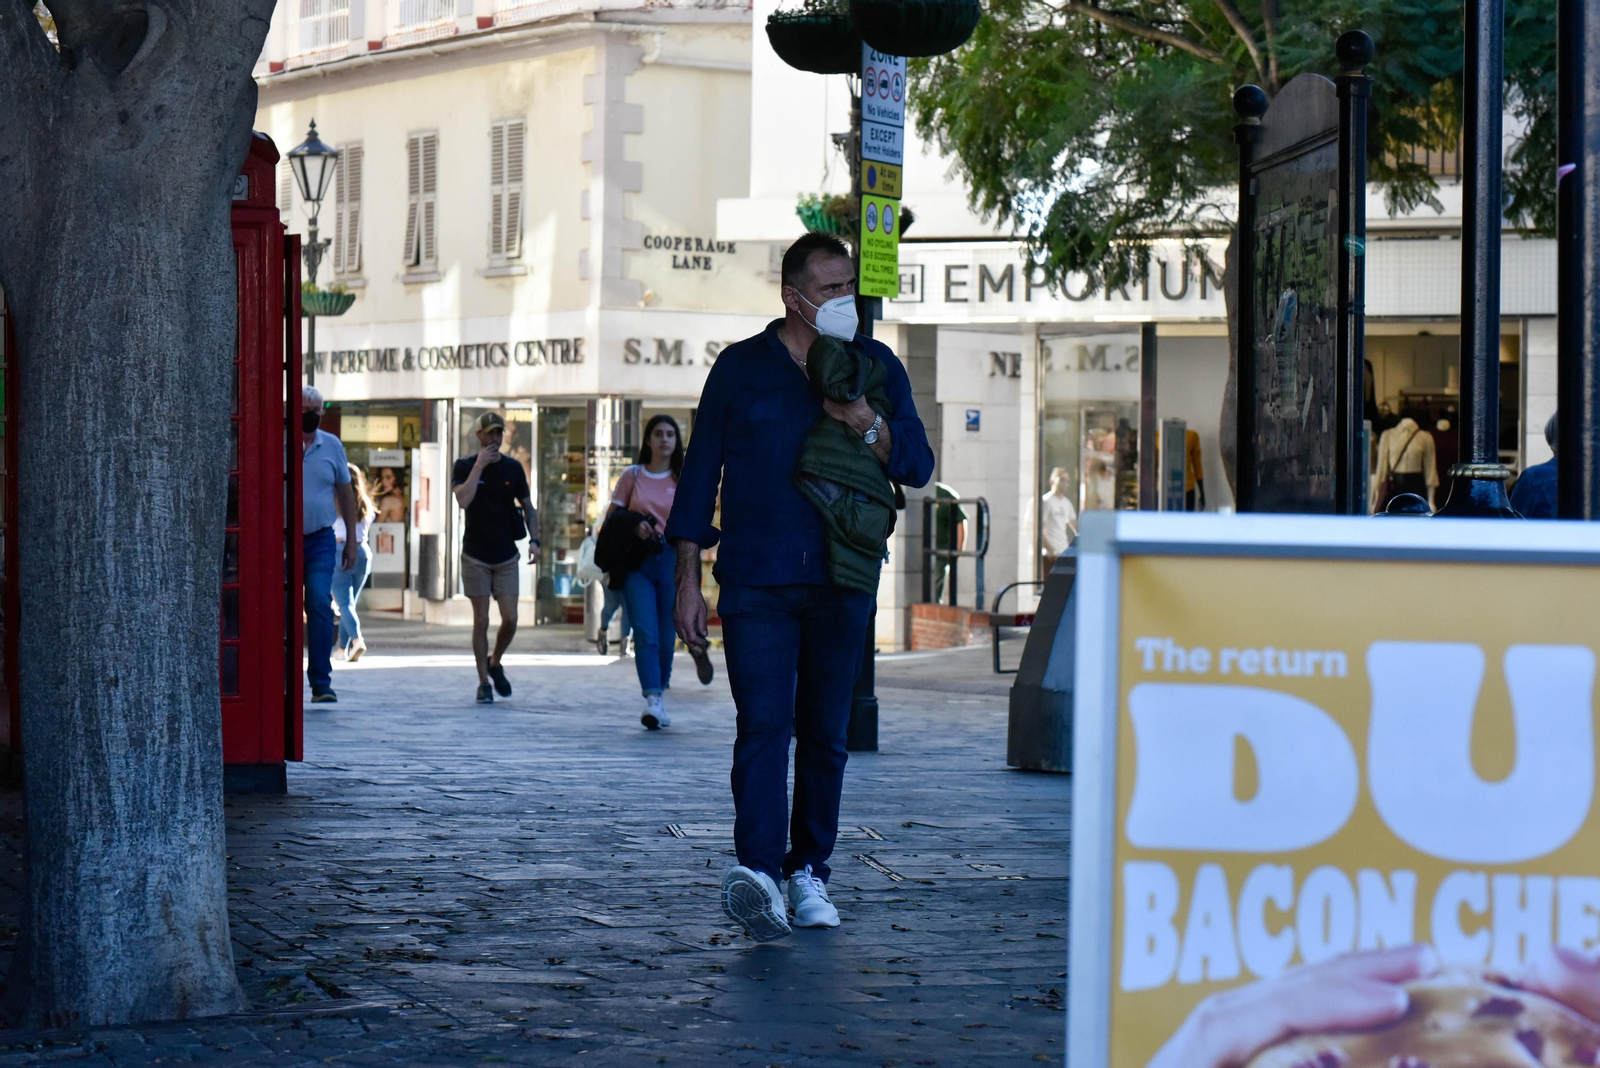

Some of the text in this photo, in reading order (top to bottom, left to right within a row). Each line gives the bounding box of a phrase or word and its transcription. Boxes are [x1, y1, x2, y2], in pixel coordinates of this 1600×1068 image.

[870, 49, 899, 66] ZONE
[867, 104, 900, 121] No Vehicles
[870, 128, 896, 144] EXCEPT
[865, 142, 901, 159] Permit Holders
[880, 166, 897, 182] At any
[882, 181, 895, 193] time
[643, 235, 737, 254] COOPERAGE
[867, 238, 893, 250] NO CYCLING
[672, 255, 712, 271] LANE
[862, 250, 870, 259] NO
[865, 263, 894, 275] AT ALL TIMES
[331, 347, 400, 375] PERFUME
[402, 347, 415, 372] &
[418, 342, 509, 371] COSMETICS
[514, 337, 585, 367] CENTRE
[623, 337, 694, 366] S.M.
[1134, 637, 1348, 678] The return
[1125, 641, 1598, 865] DU
[1120, 860, 1418, 992] BACON
